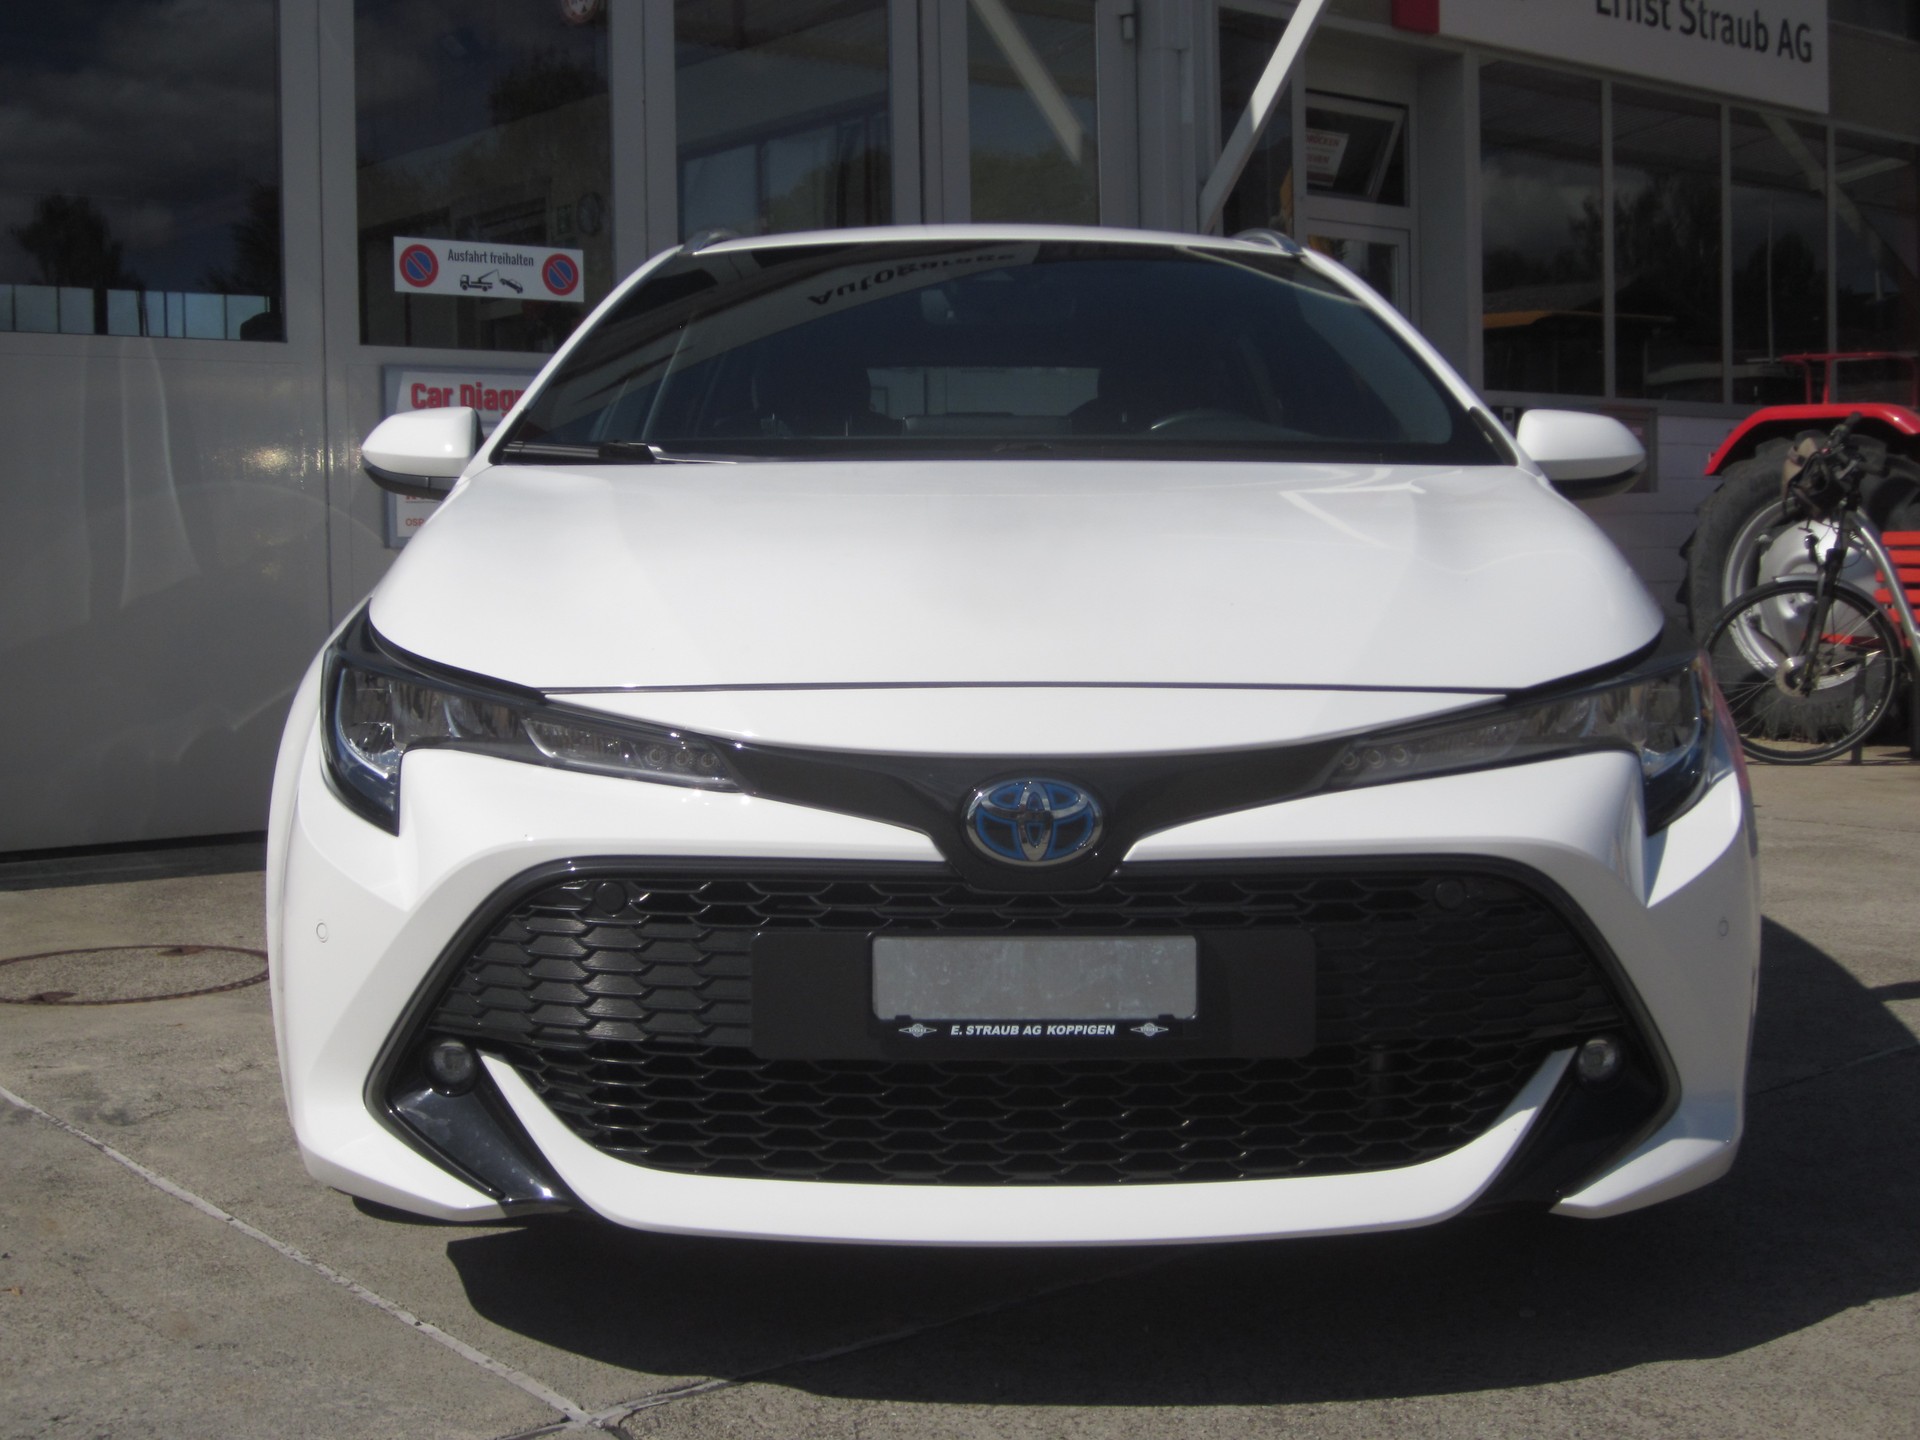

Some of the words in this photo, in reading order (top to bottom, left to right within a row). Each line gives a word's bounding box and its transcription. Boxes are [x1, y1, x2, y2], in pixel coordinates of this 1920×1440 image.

[1679, 0, 1769, 52] Straub
[1777, 18, 1813, 63] AG
[448, 248, 487, 263] Ausfahrt
[490, 253, 534, 266] freihalten
[411, 382, 453, 410] Car
[950, 1025, 963, 1036] E.
[965, 1025, 1019, 1036] STRAUB
[1022, 1025, 1042, 1036] AG
[1046, 1024, 1116, 1036] KOPPIGEN
